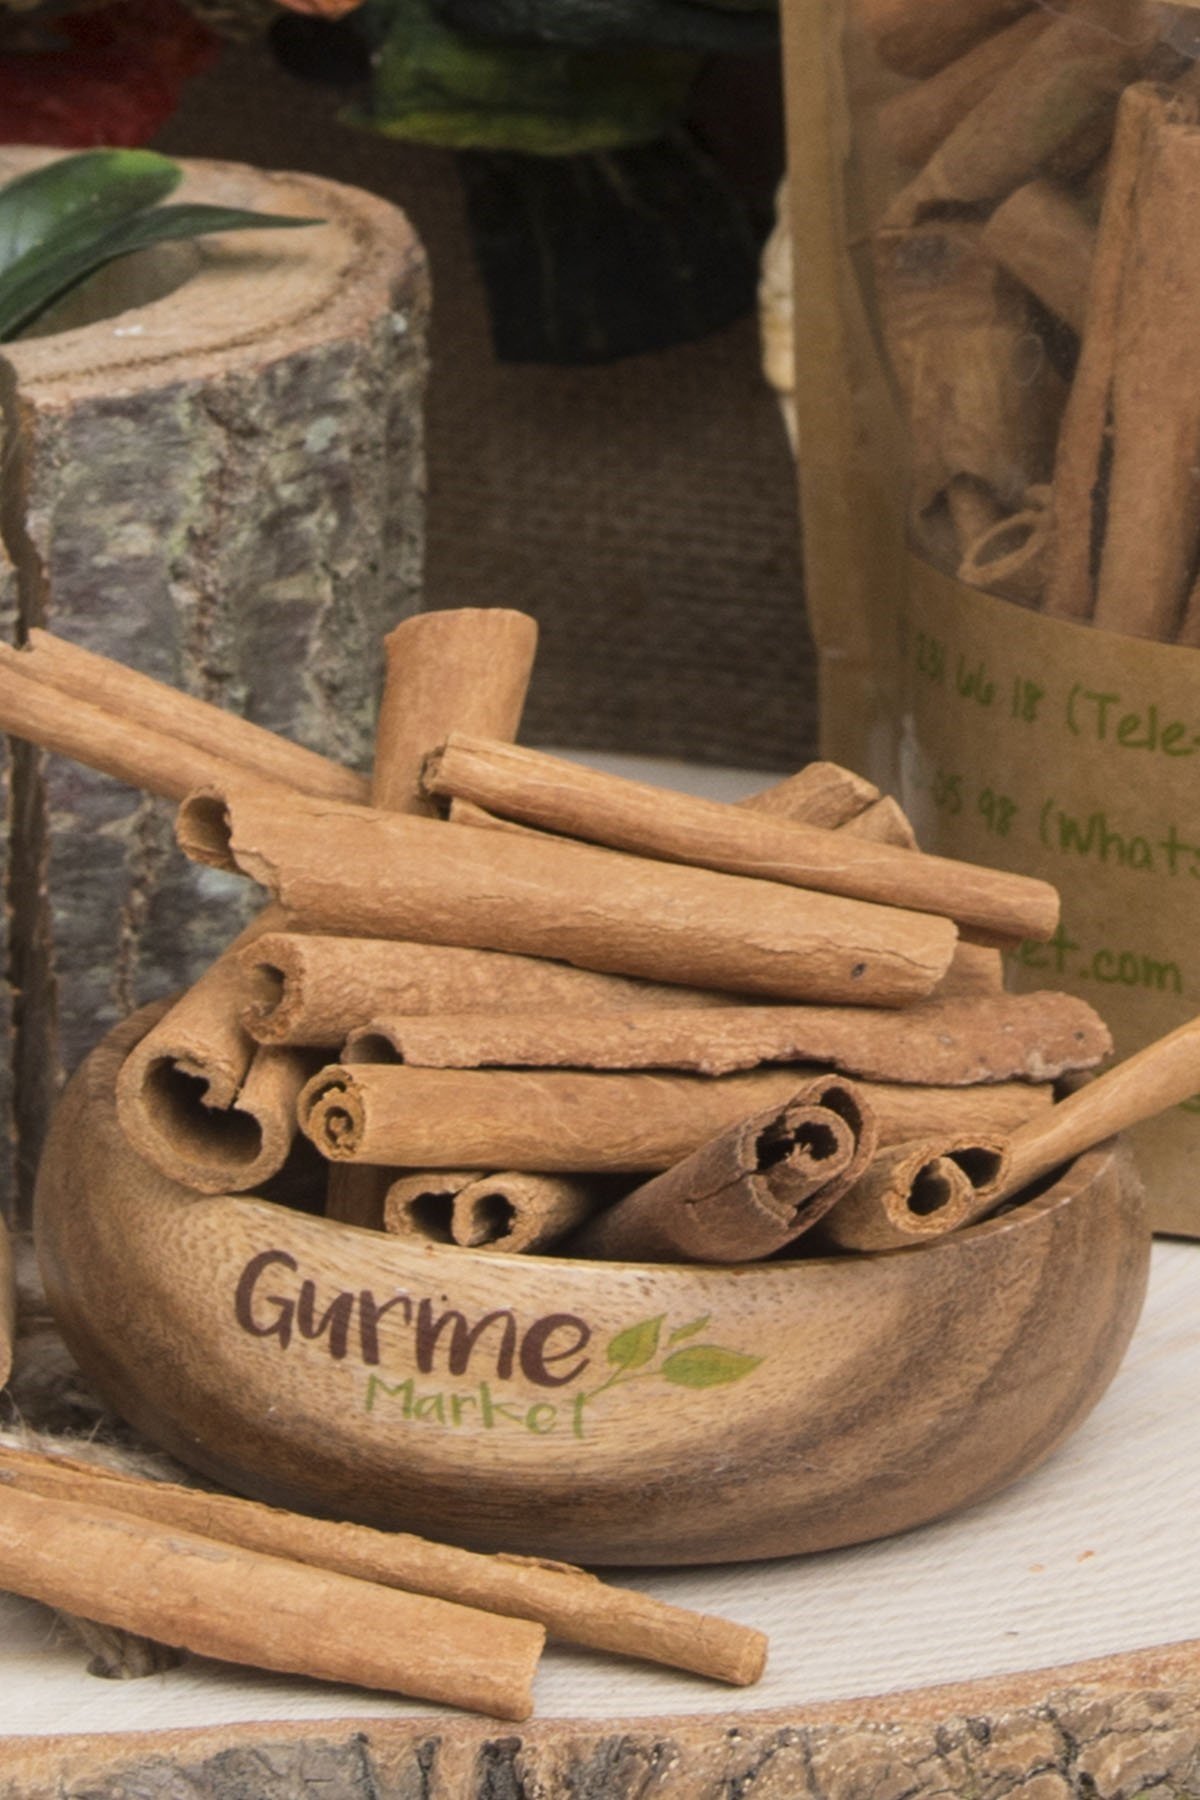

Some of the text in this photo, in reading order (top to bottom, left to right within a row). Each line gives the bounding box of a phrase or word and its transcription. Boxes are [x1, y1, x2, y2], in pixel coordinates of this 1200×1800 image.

[1012, 674, 1045, 723] 18
[1066, 682, 1200, 757] (Tele
[1016, 923, 1183, 994] et.com
[234, 1249, 592, 1388] Gurme
[365, 1371, 588, 1440] Market
